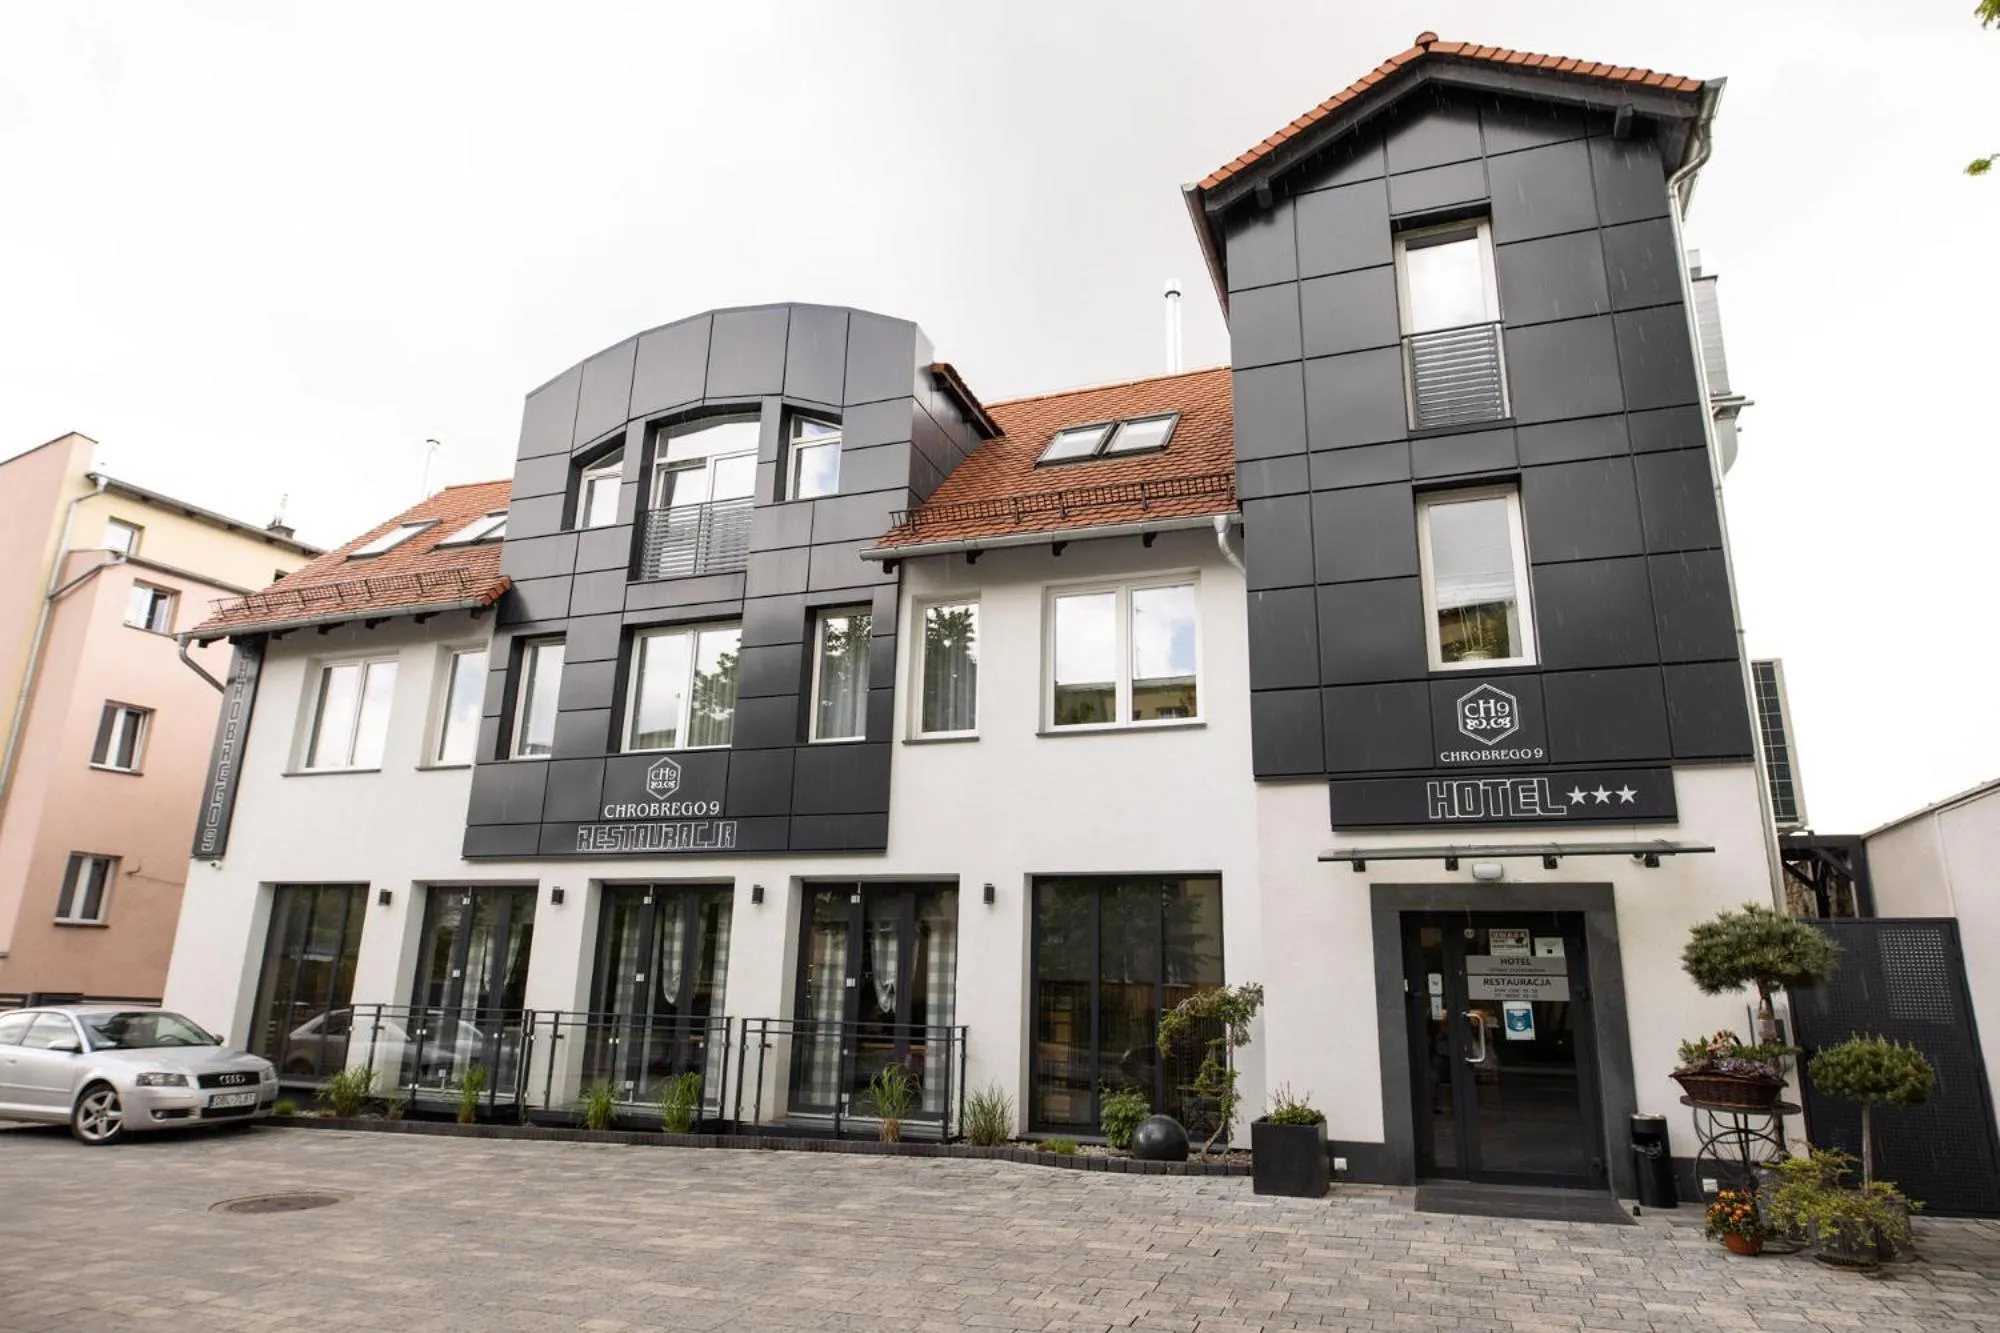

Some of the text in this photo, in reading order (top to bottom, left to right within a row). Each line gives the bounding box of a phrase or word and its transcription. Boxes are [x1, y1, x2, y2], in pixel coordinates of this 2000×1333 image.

[1464, 699, 1509, 718] CH9
[651, 767, 676, 781] CH9
[1427, 778, 1567, 819] HOTEL
[576, 821, 737, 851] RESTAURACJA
[1500, 957, 1532, 966] HOTEL
[1483, 978, 1552, 986] RESTAURACJA
